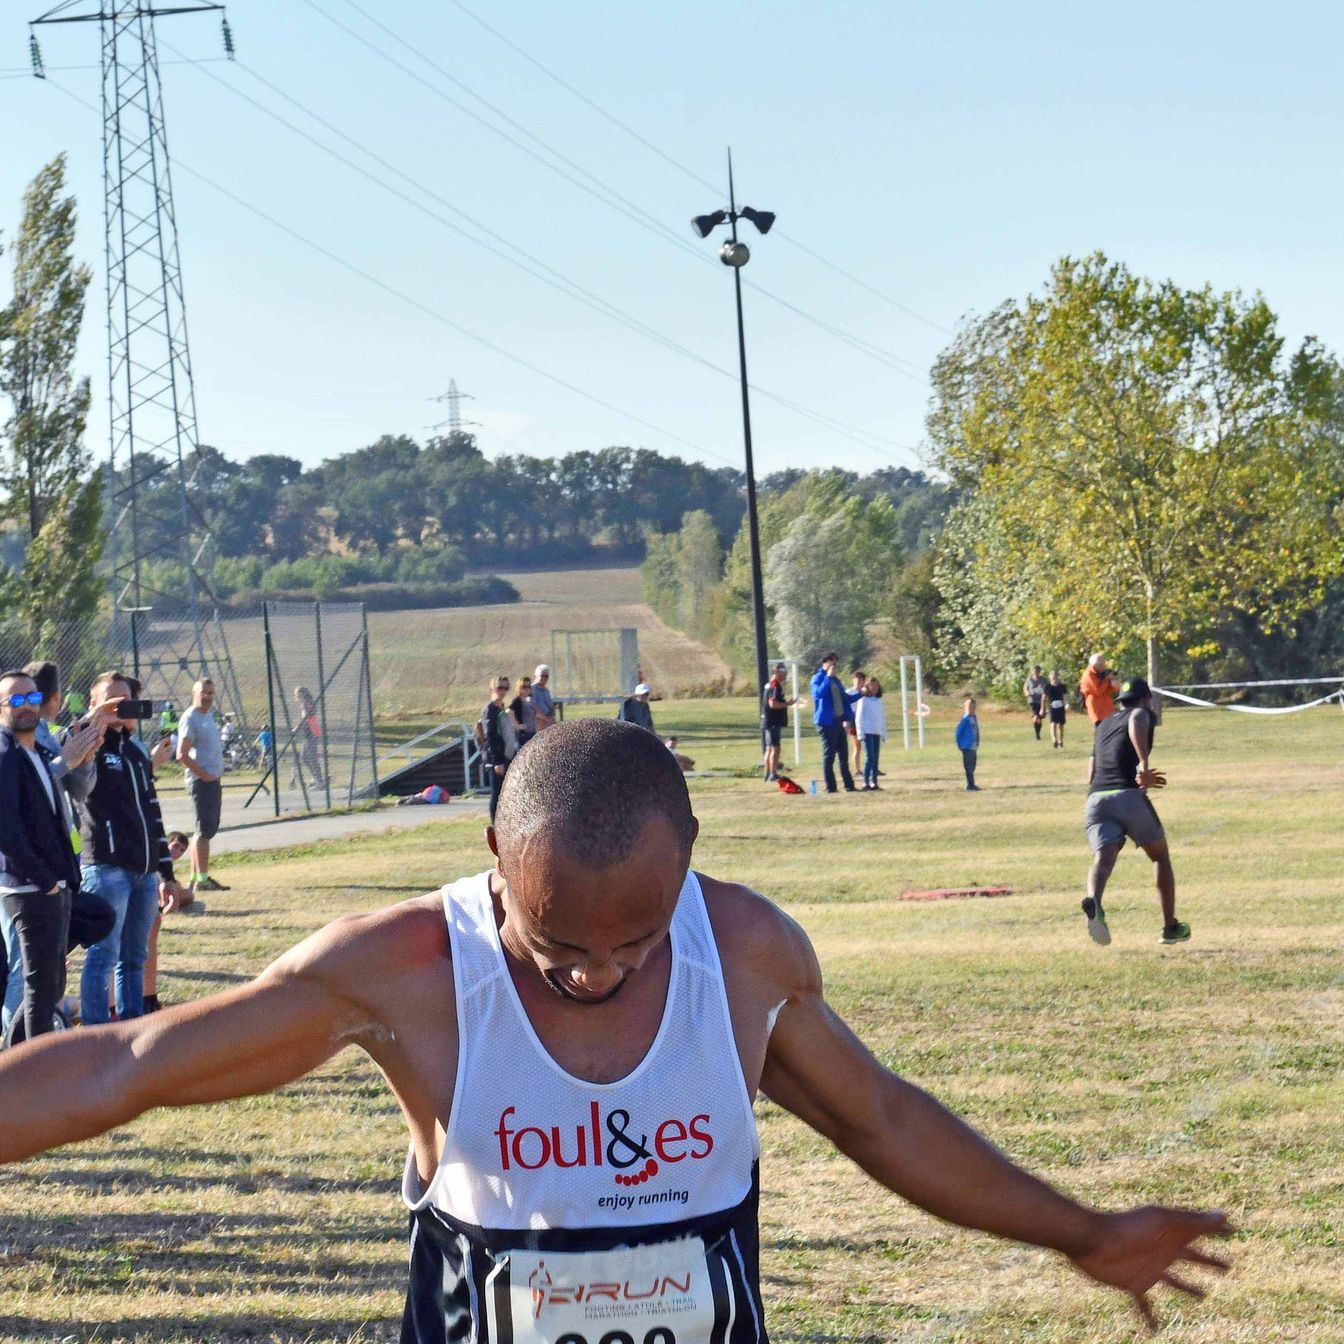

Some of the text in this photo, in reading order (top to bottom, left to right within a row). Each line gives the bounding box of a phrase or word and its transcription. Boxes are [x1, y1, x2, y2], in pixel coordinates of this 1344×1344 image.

[494, 1101, 714, 1171] foul&es
[598, 1189, 689, 1211] enjoy running
